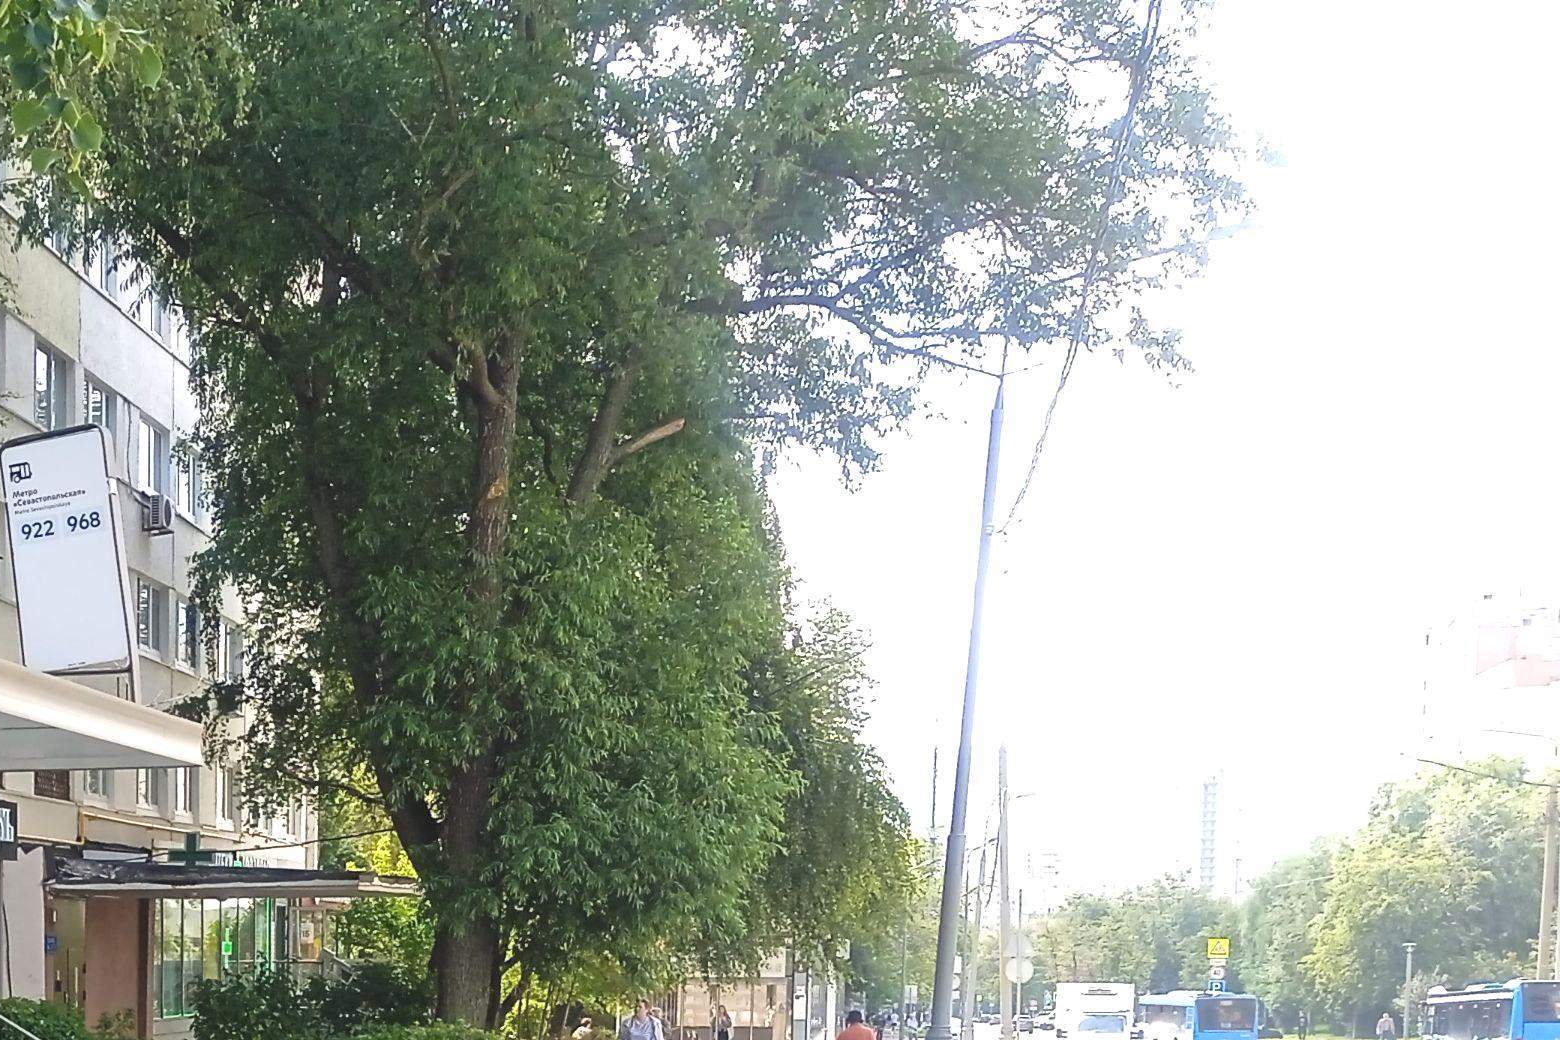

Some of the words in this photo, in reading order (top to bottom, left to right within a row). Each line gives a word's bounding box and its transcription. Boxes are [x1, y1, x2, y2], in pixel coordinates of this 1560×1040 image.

[13, 489, 38, 499] Метро
[21, 520, 55, 540] 922
[66, 511, 101, 533] 968
